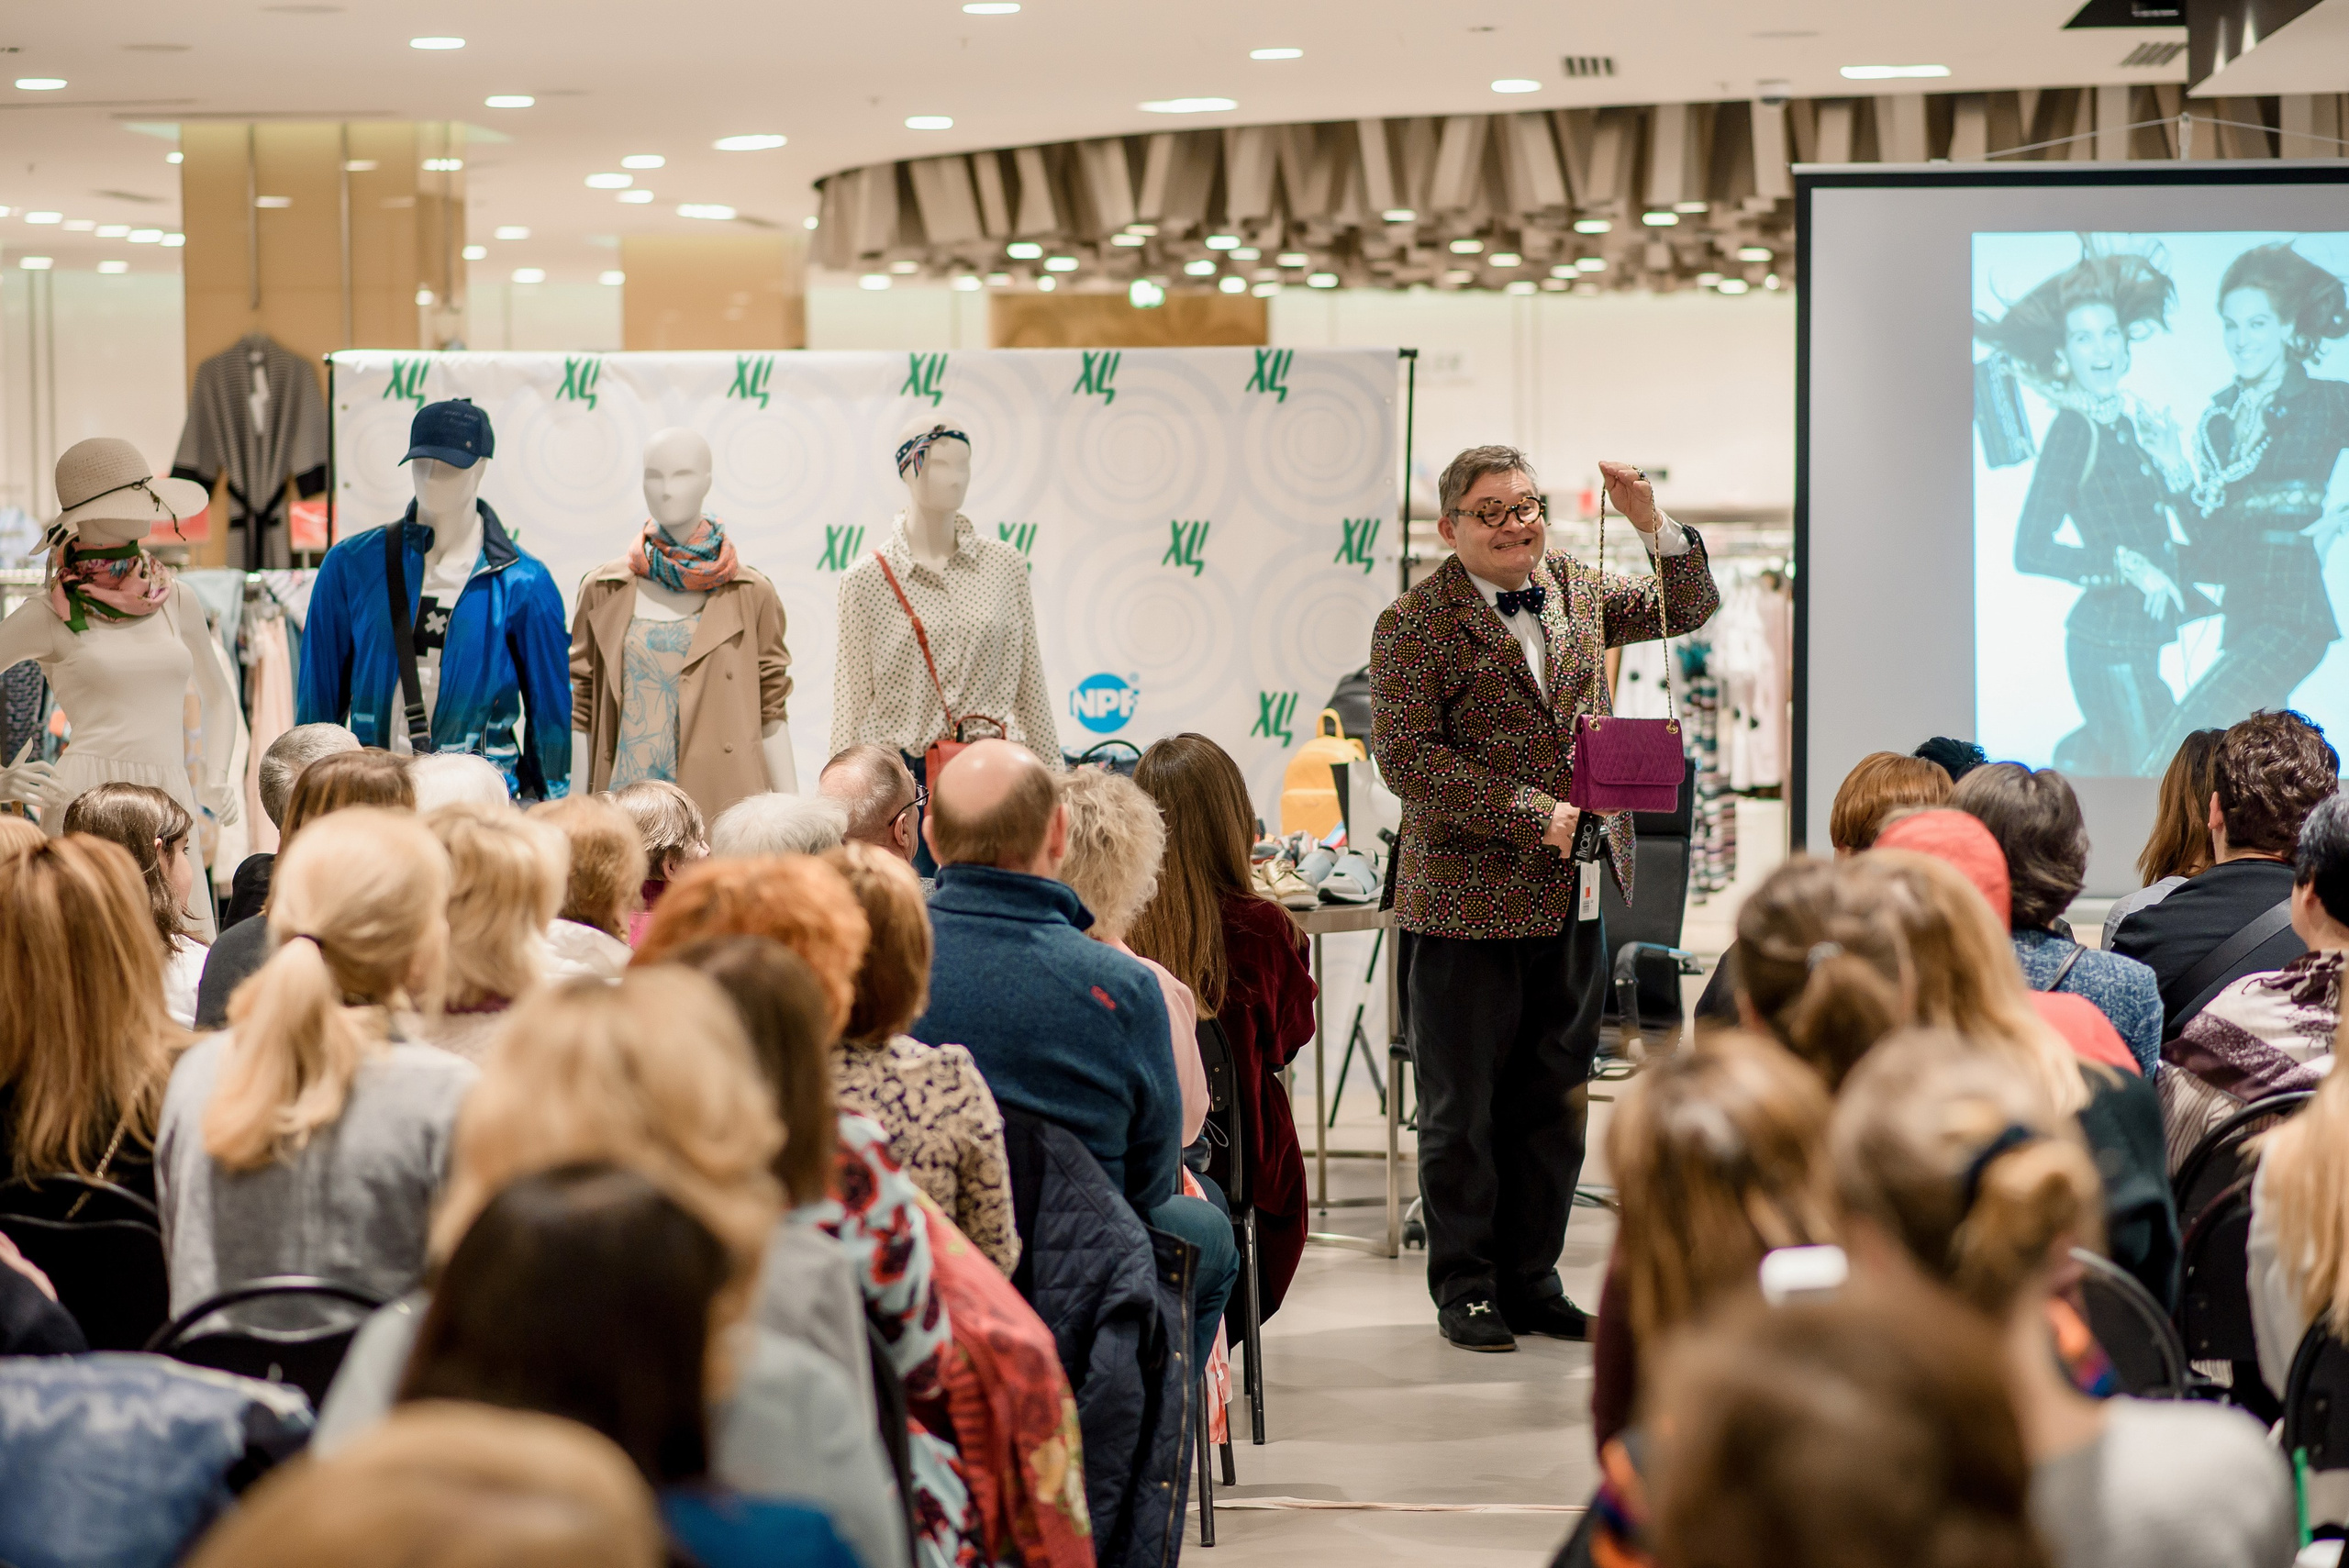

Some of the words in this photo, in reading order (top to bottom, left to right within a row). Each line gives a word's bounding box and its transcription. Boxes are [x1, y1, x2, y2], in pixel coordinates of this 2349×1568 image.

[555, 356, 602, 411] ХЦ
[728, 355, 774, 410] ХЦ
[900, 352, 948, 406] ХЦ
[1073, 350, 1121, 405] ХЦ
[1246, 349, 1294, 403] ХЦ
[1162, 519, 1209, 576] ХЦ
[1334, 517, 1380, 574] ХЦ
[1070, 687, 1140, 718] NPF
[1251, 691, 1298, 748] ХЦ
